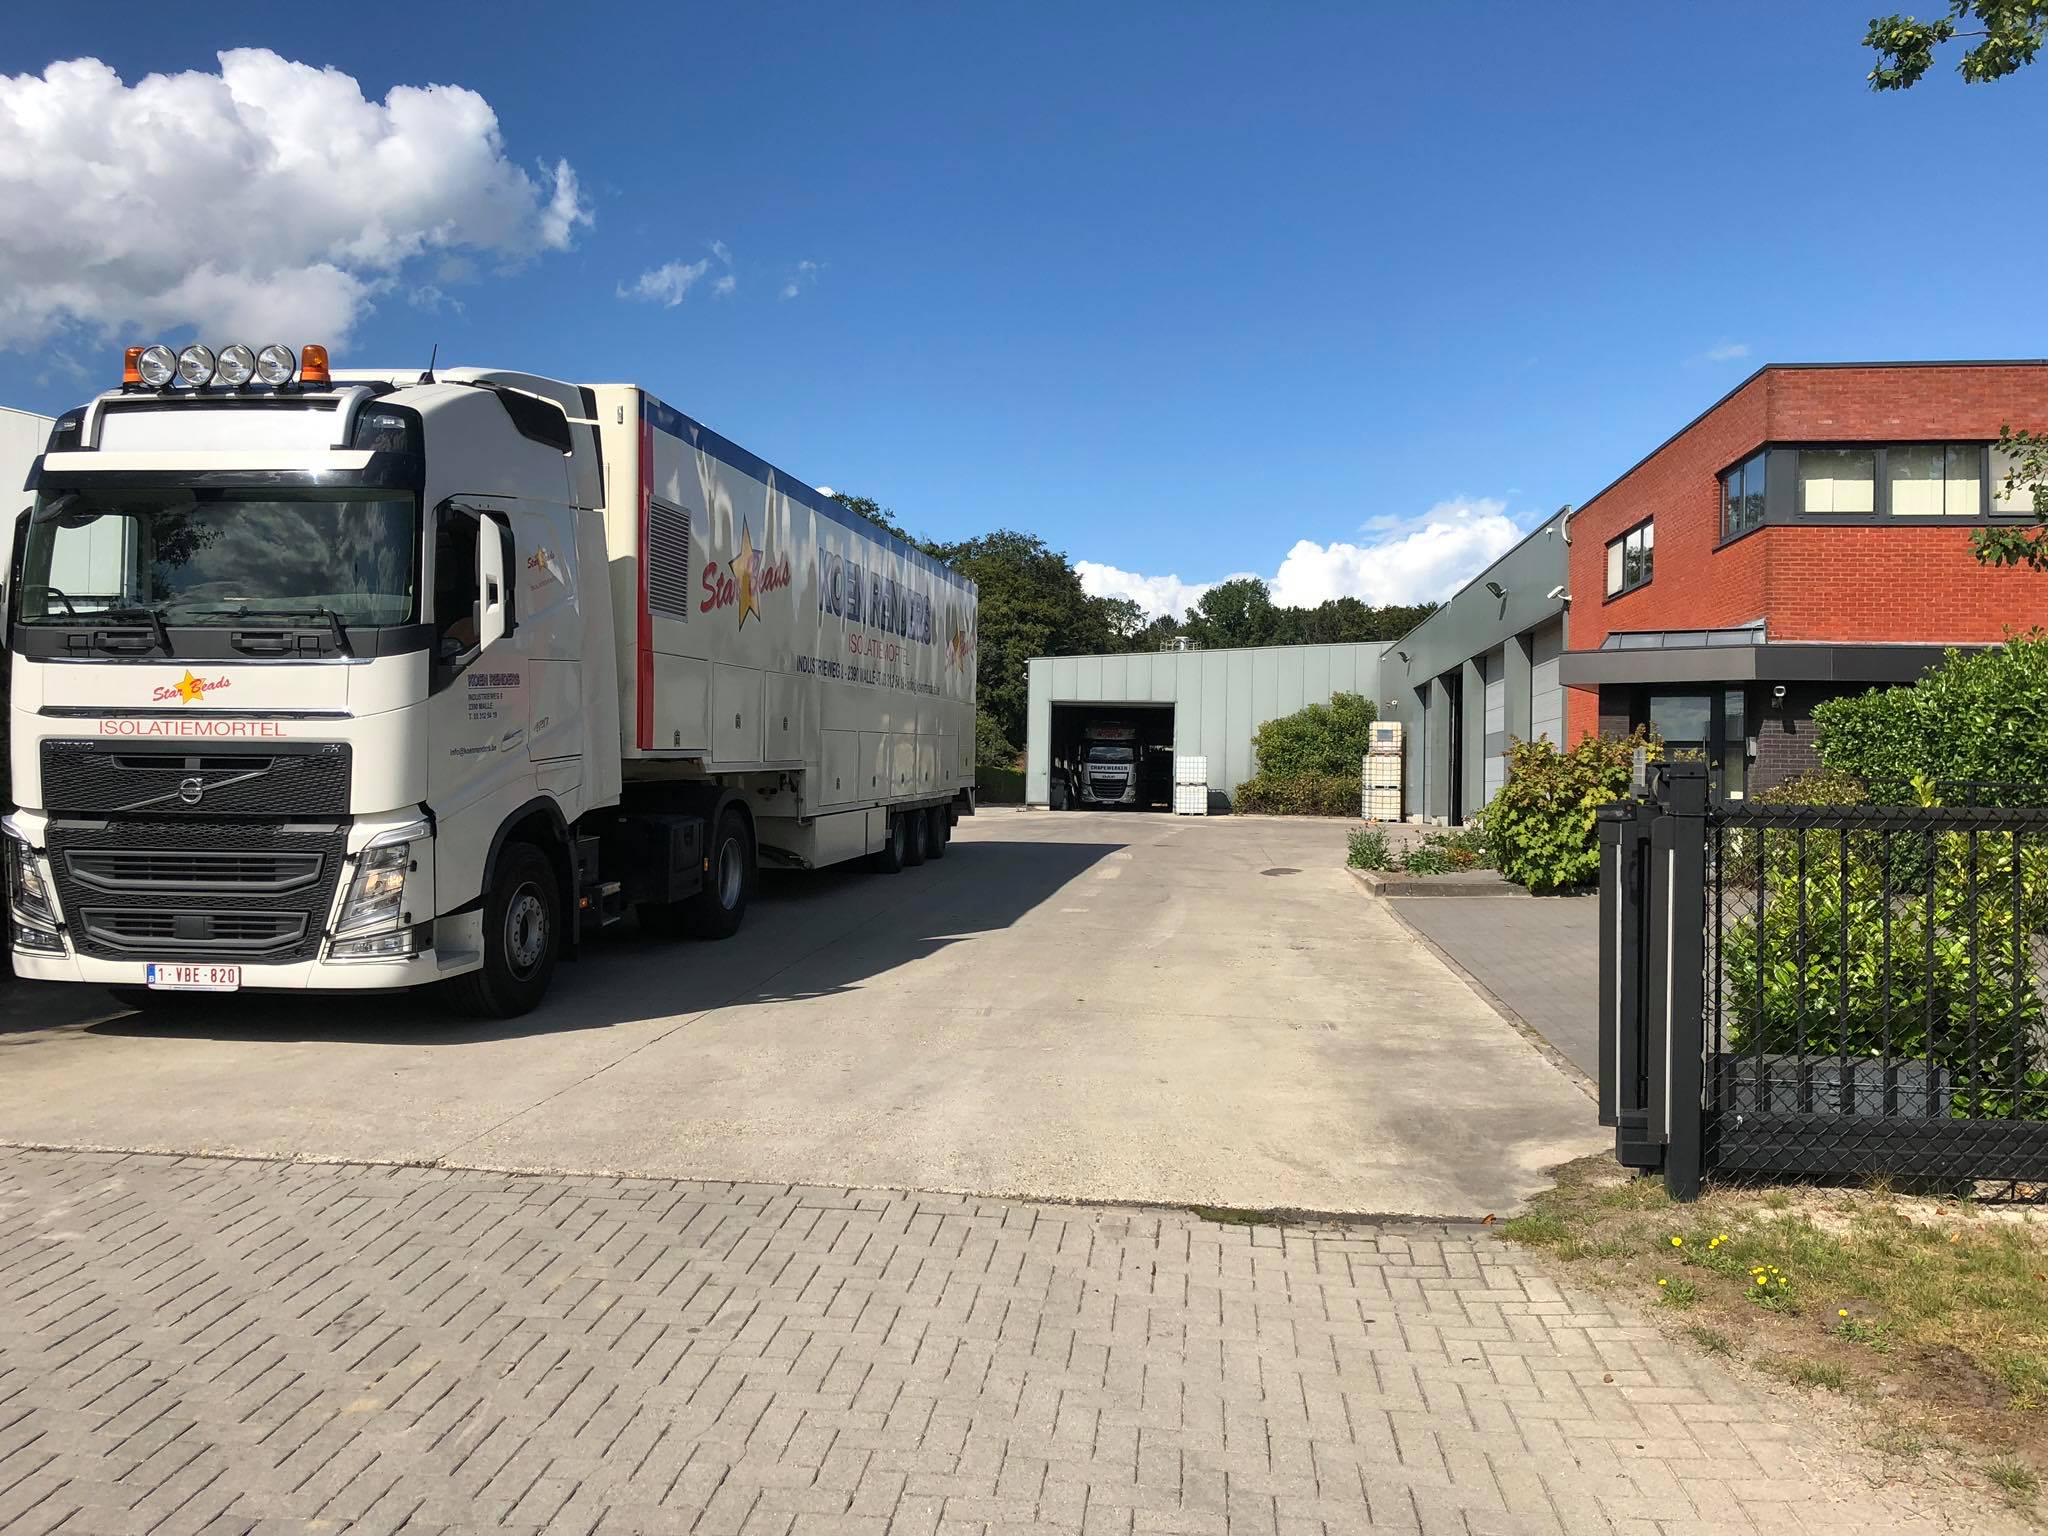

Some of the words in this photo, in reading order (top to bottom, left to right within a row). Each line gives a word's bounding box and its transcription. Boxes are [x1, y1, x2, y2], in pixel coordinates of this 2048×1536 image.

[152, 687, 184, 701] Star
[189, 676, 232, 694] Beads
[100, 720, 287, 736] ISOLATIEMORTEL
[158, 967, 235, 983] 1-VBE-820
